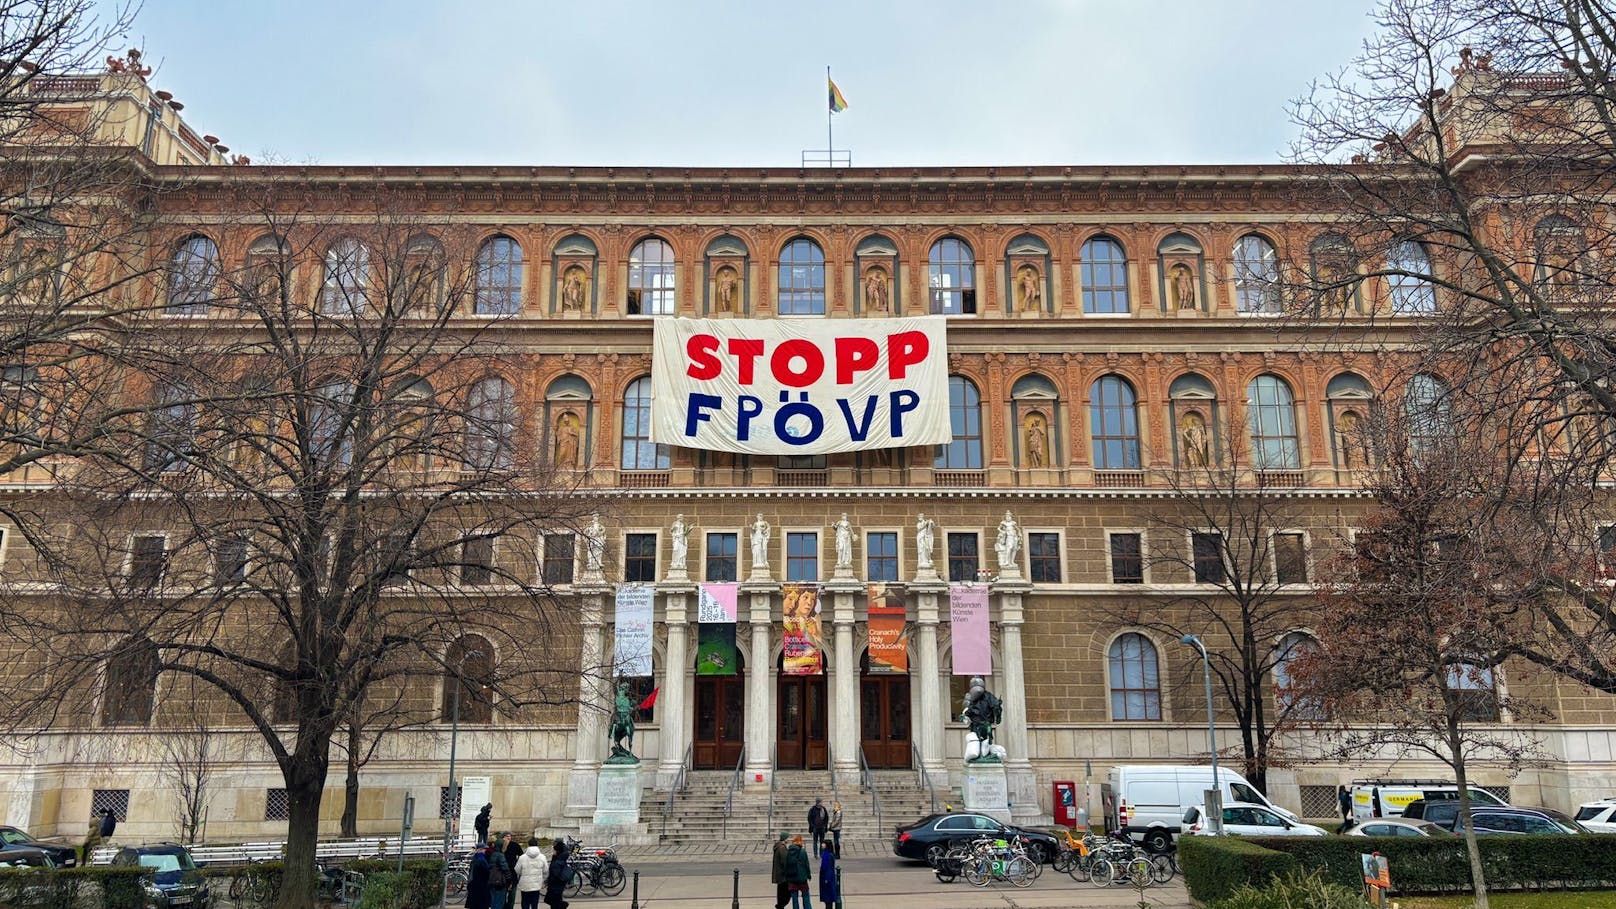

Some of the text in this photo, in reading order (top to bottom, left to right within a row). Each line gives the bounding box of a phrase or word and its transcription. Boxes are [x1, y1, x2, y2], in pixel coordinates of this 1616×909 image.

[686, 331, 930, 387] STOPP
[685, 390, 920, 445] FPÖVP
[869, 643, 905, 651] Productivity
